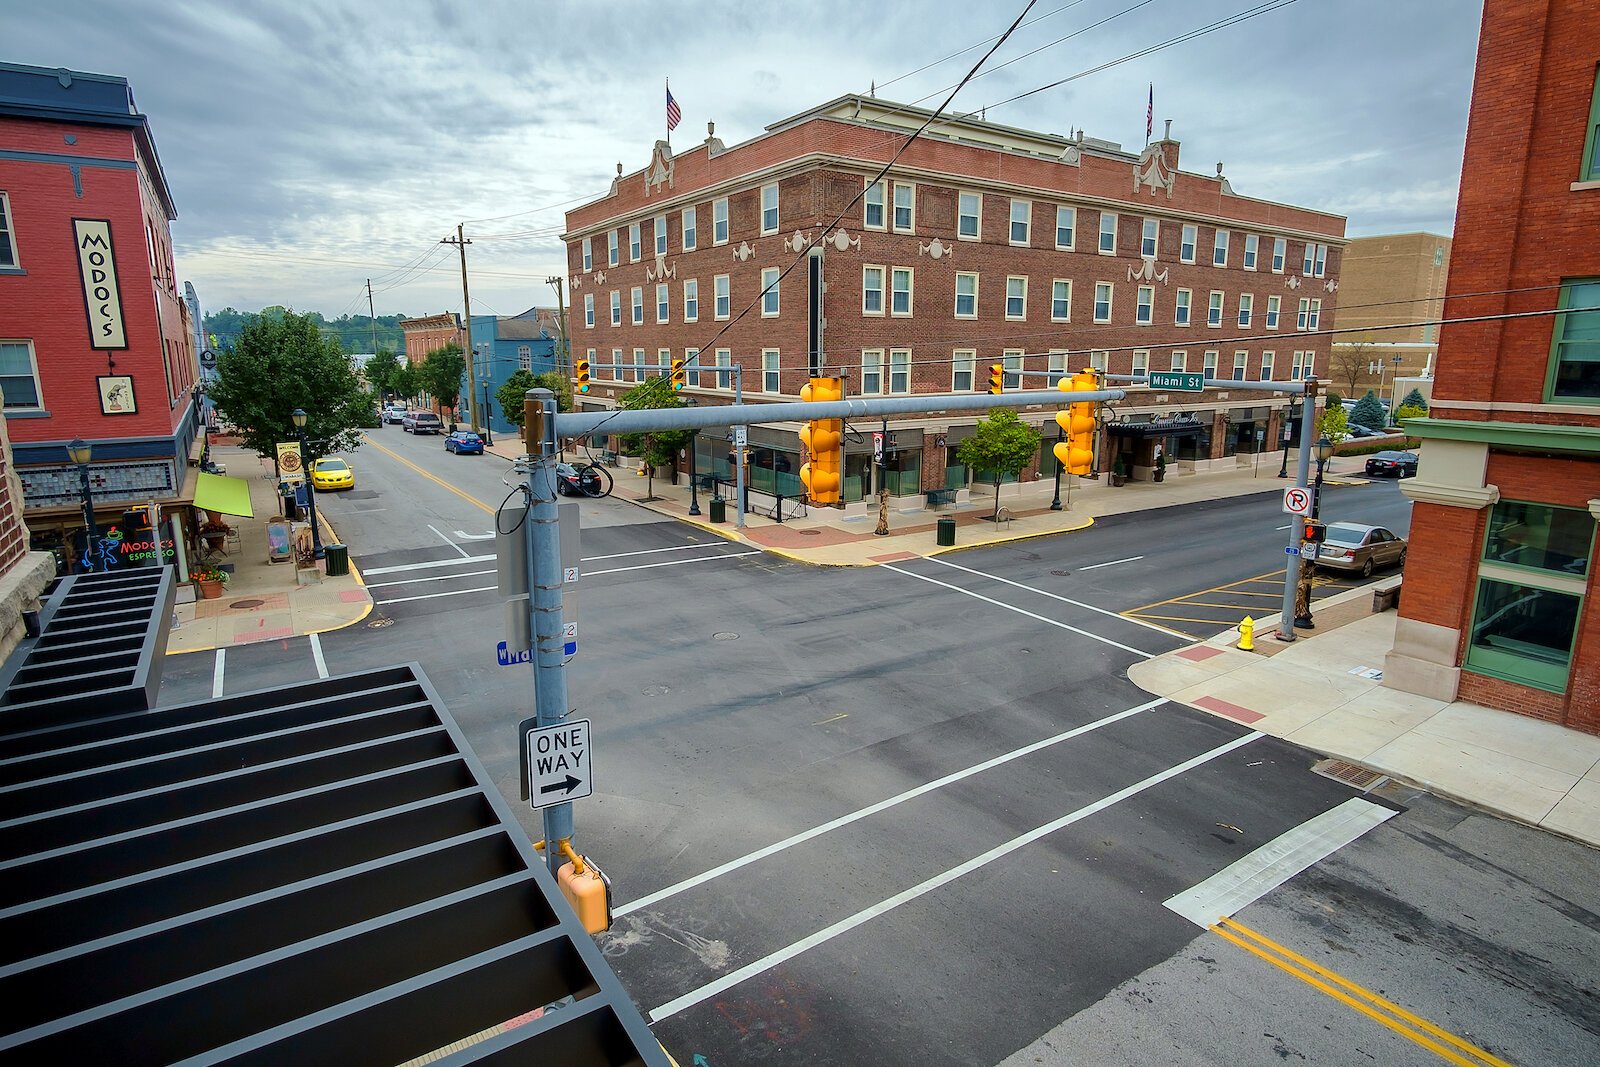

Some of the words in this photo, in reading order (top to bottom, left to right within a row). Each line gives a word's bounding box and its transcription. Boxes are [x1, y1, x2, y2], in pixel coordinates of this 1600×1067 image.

[81, 233, 113, 337] MODOC'S
[1153, 375, 1183, 387] Miami
[1188, 377, 1200, 388] St
[128, 549, 175, 561] ESPRESO
[568, 569, 575, 581] 2
[567, 624, 575, 636] 2
[537, 728, 583, 754] ONE
[536, 749, 585, 776] WAY
